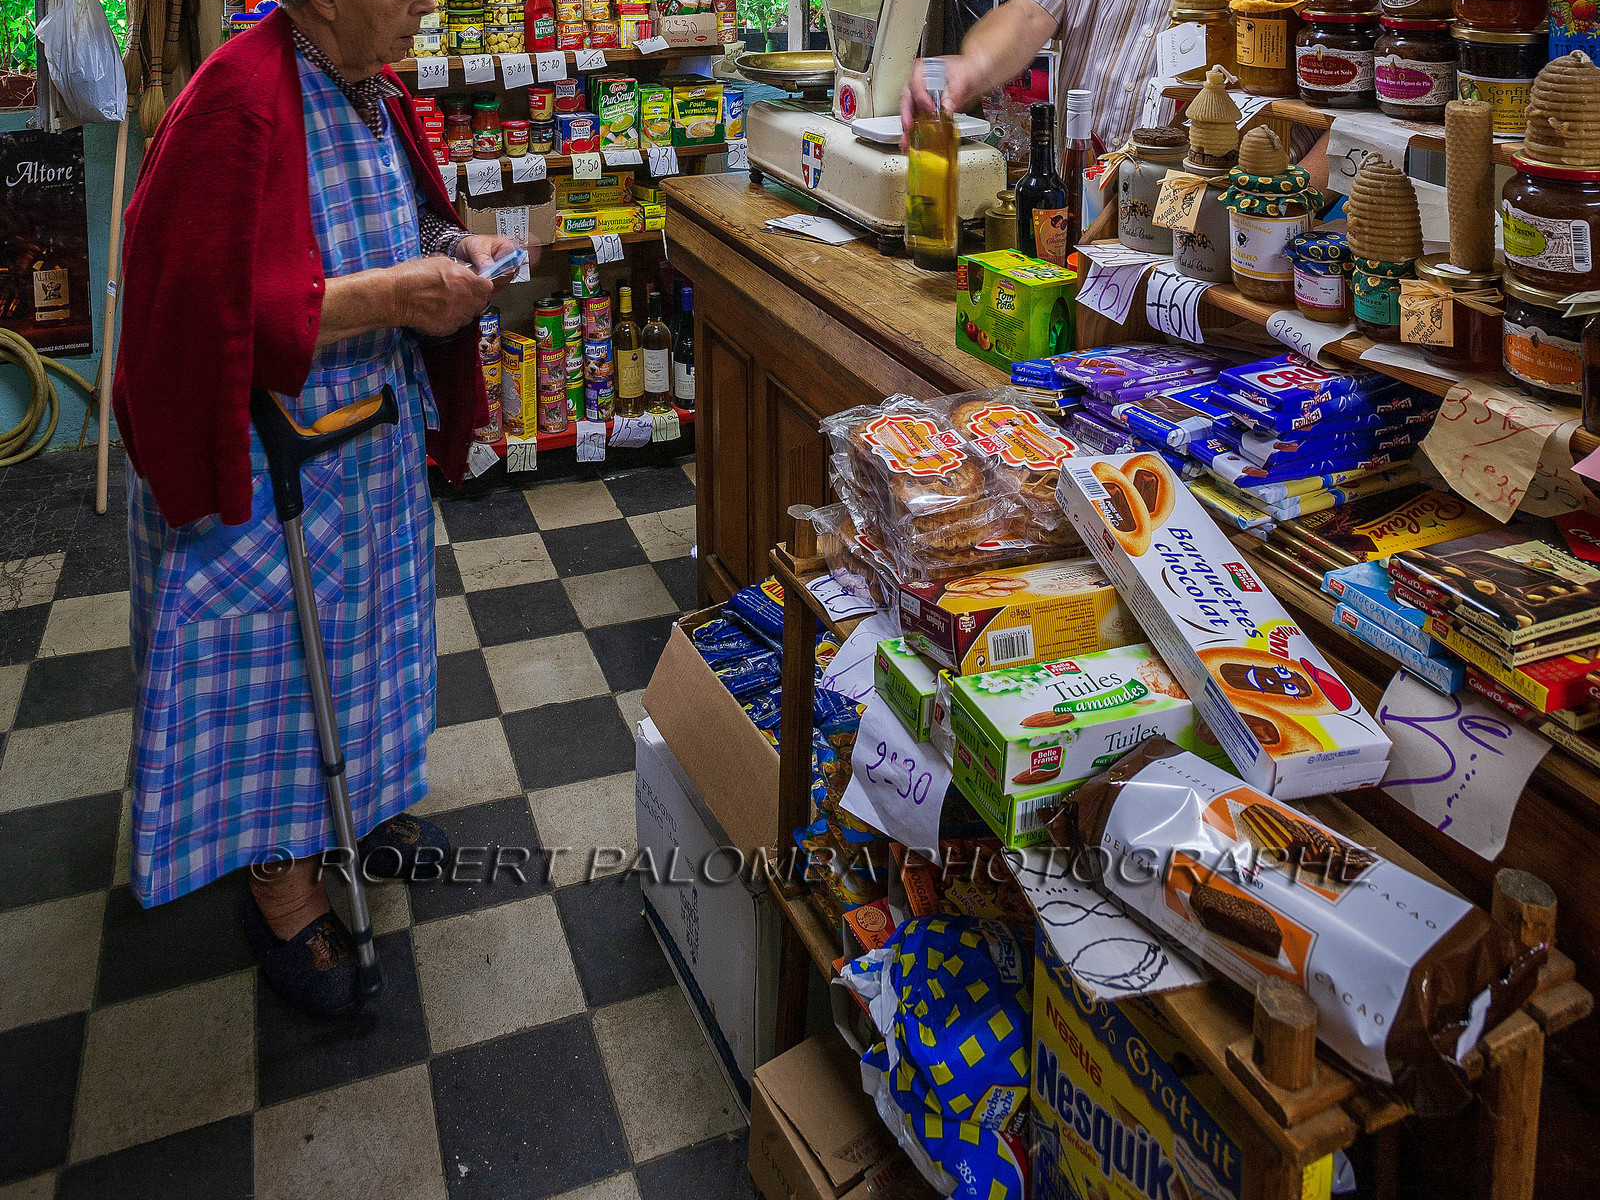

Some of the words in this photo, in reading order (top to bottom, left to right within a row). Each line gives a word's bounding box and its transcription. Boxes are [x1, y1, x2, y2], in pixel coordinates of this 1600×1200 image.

[1488, 85, 1530, 96] Confit
[684, 107, 717, 115] vermicelles
[6, 160, 73, 187] Altore
[565, 217, 596, 232] Bénédicta
[598, 217, 634, 228] Mayonnaise
[1166, 211, 1183, 229] CORSE
[1419, 326, 1436, 344] CORSE
[1536, 356, 1547, 365] de
[1548, 361, 1573, 373] Melon
[1370, 500, 1466, 542] Poulain
[1154, 542, 1232, 628] chocolat
[1167, 527, 1265, 639] Barquettes
[1050, 667, 1076, 678] France
[1051, 663, 1071, 672] Belle
[1045, 671, 1122, 705] Tuiles
[1054, 705, 1073, 714] aux
[1075, 682, 1146, 713] amandes
[1485, 687, 1504, 703] d'Or
[1103, 723, 1159, 754] Tuiles
[1033, 754, 1060, 765] France
[1037, 749, 1058, 759] Belle
[1155, 758, 1218, 794] DELIZIA
[1368, 881, 1438, 930] CACAO
[1314, 971, 1386, 1027] CACAO
[1046, 994, 1105, 1088] Nestlé
[1036, 1040, 1176, 1193] Nesquik
[1125, 1035, 1242, 1175] Gratuit
[954, 1159, 978, 1186] 385
